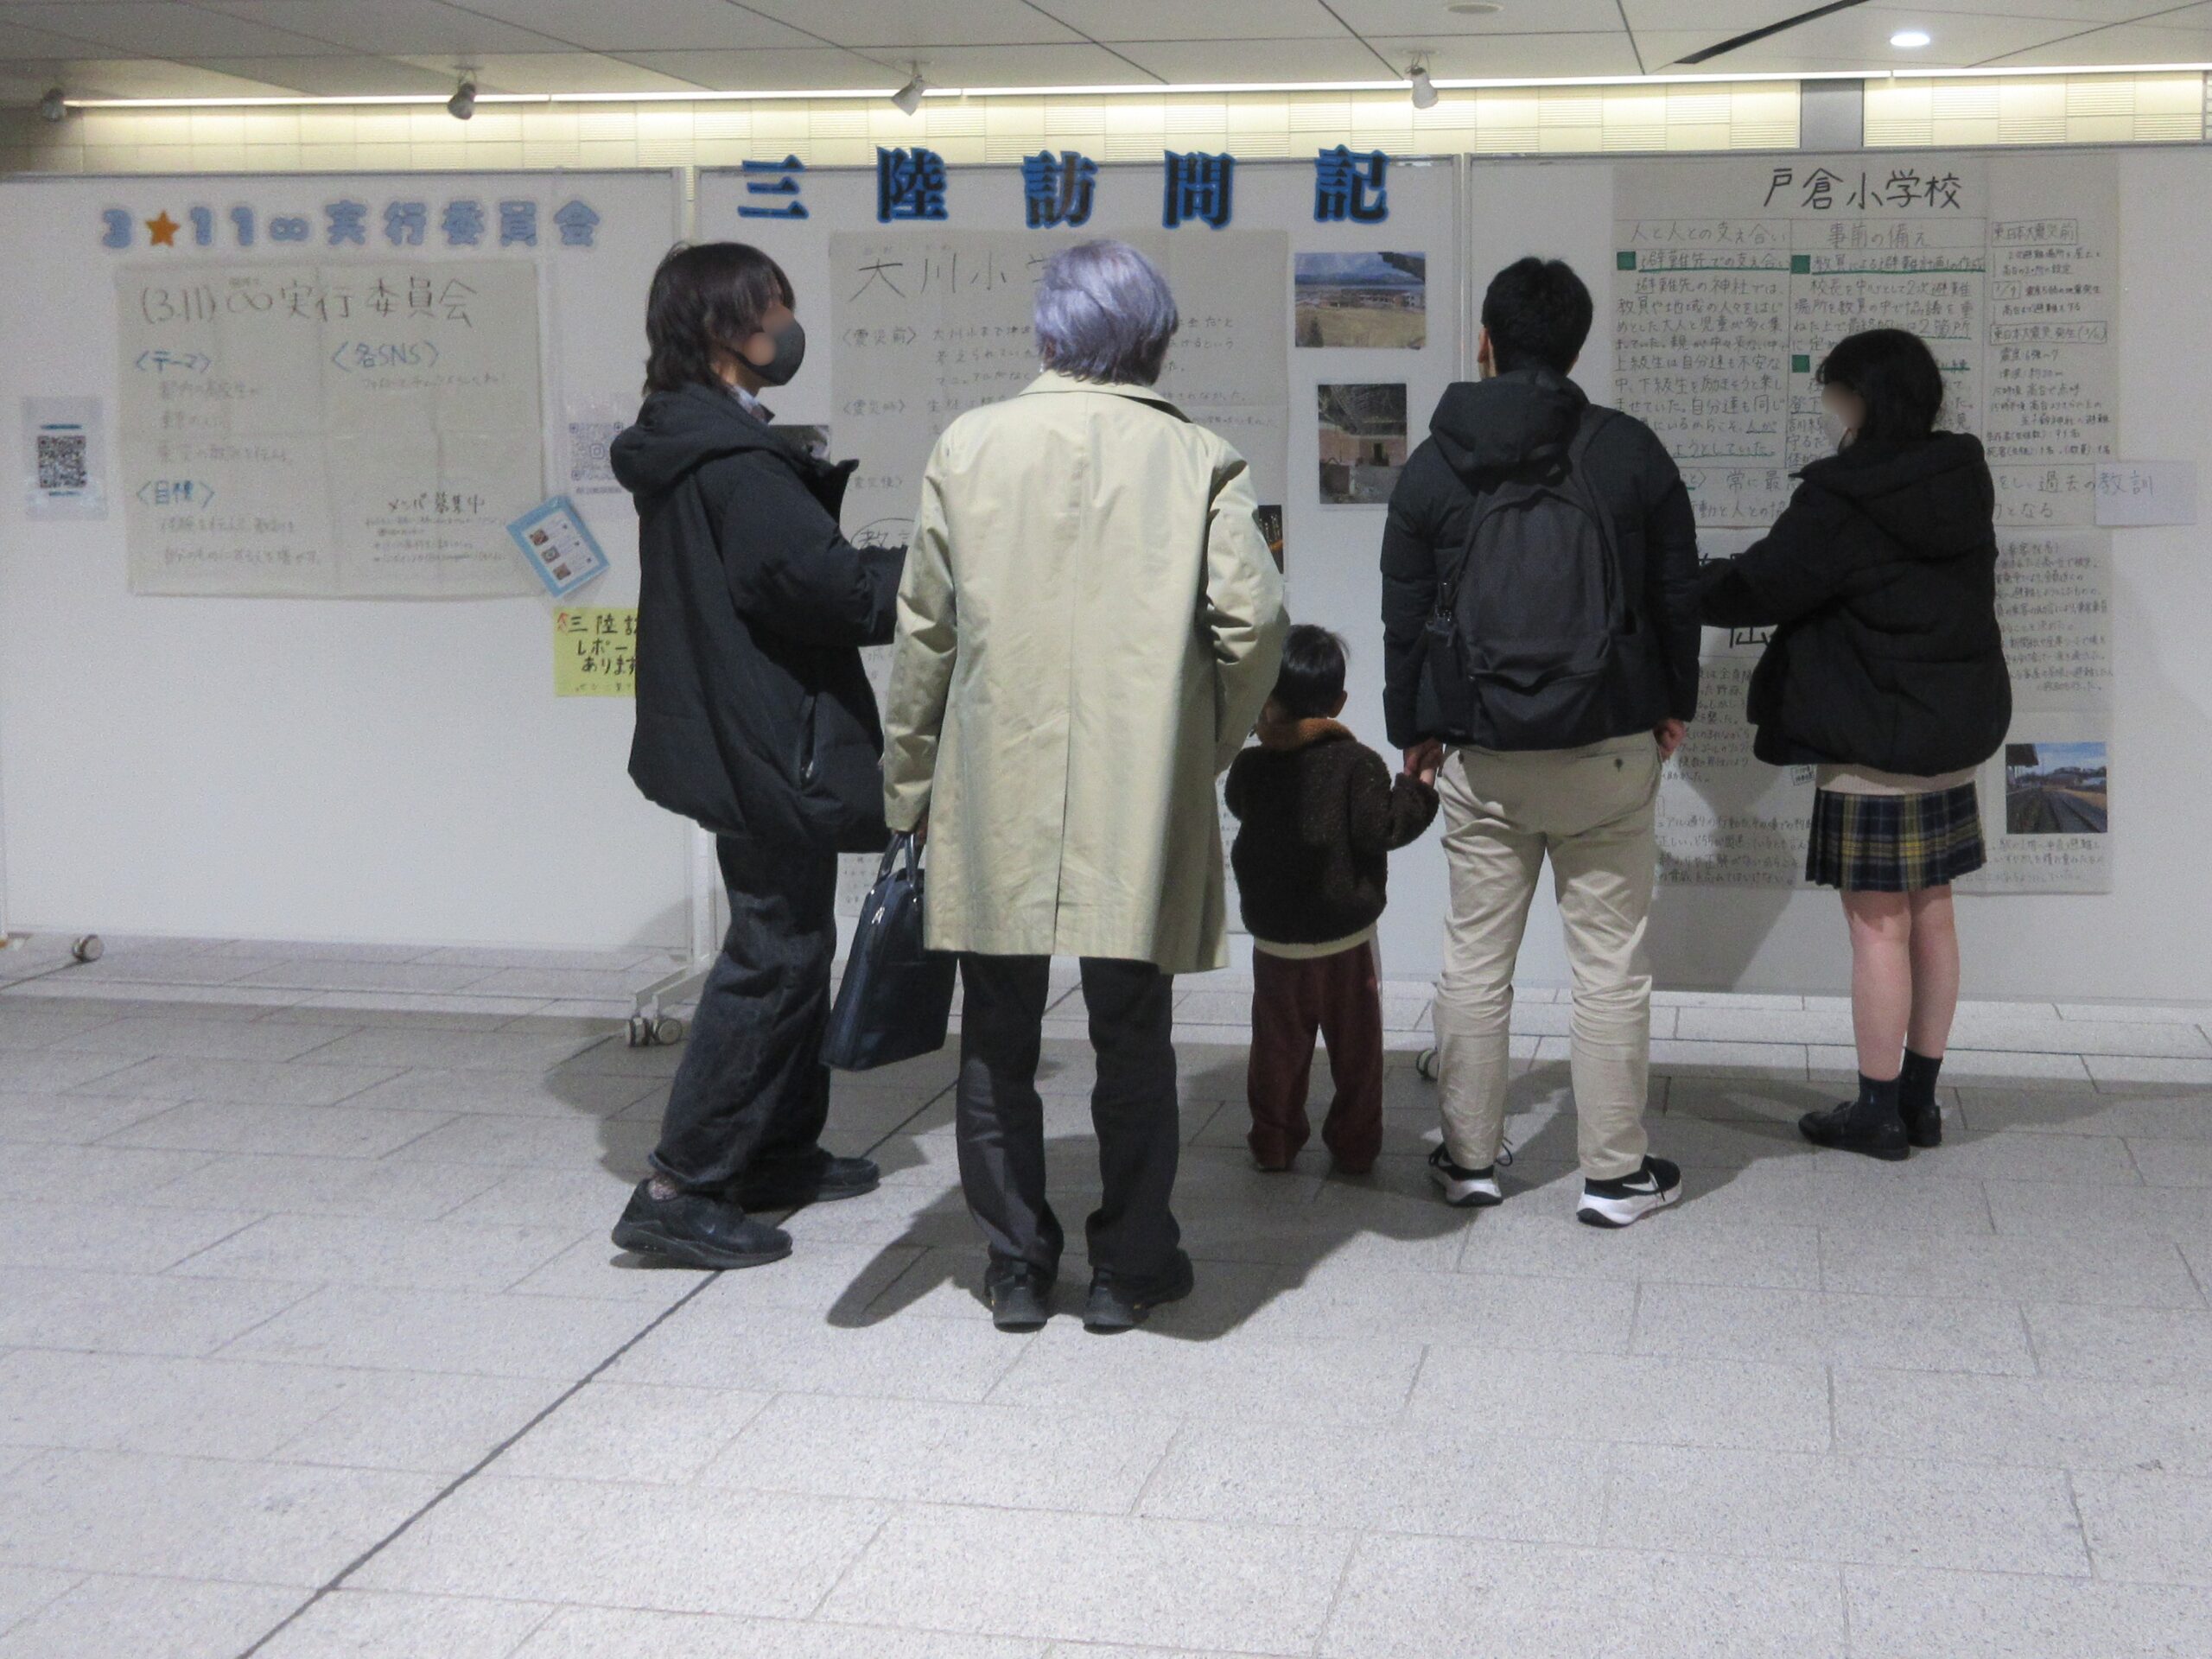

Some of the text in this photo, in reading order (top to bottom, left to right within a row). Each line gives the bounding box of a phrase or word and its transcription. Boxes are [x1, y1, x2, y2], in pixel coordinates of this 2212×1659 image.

[738, 145, 1389, 229] 三陸訪問記
[1764, 168, 1961, 209] 戸倉小学校
[1630, 221, 1786, 245] 人と人との支え合い
[1827, 223, 1930, 248] 事前の備え
